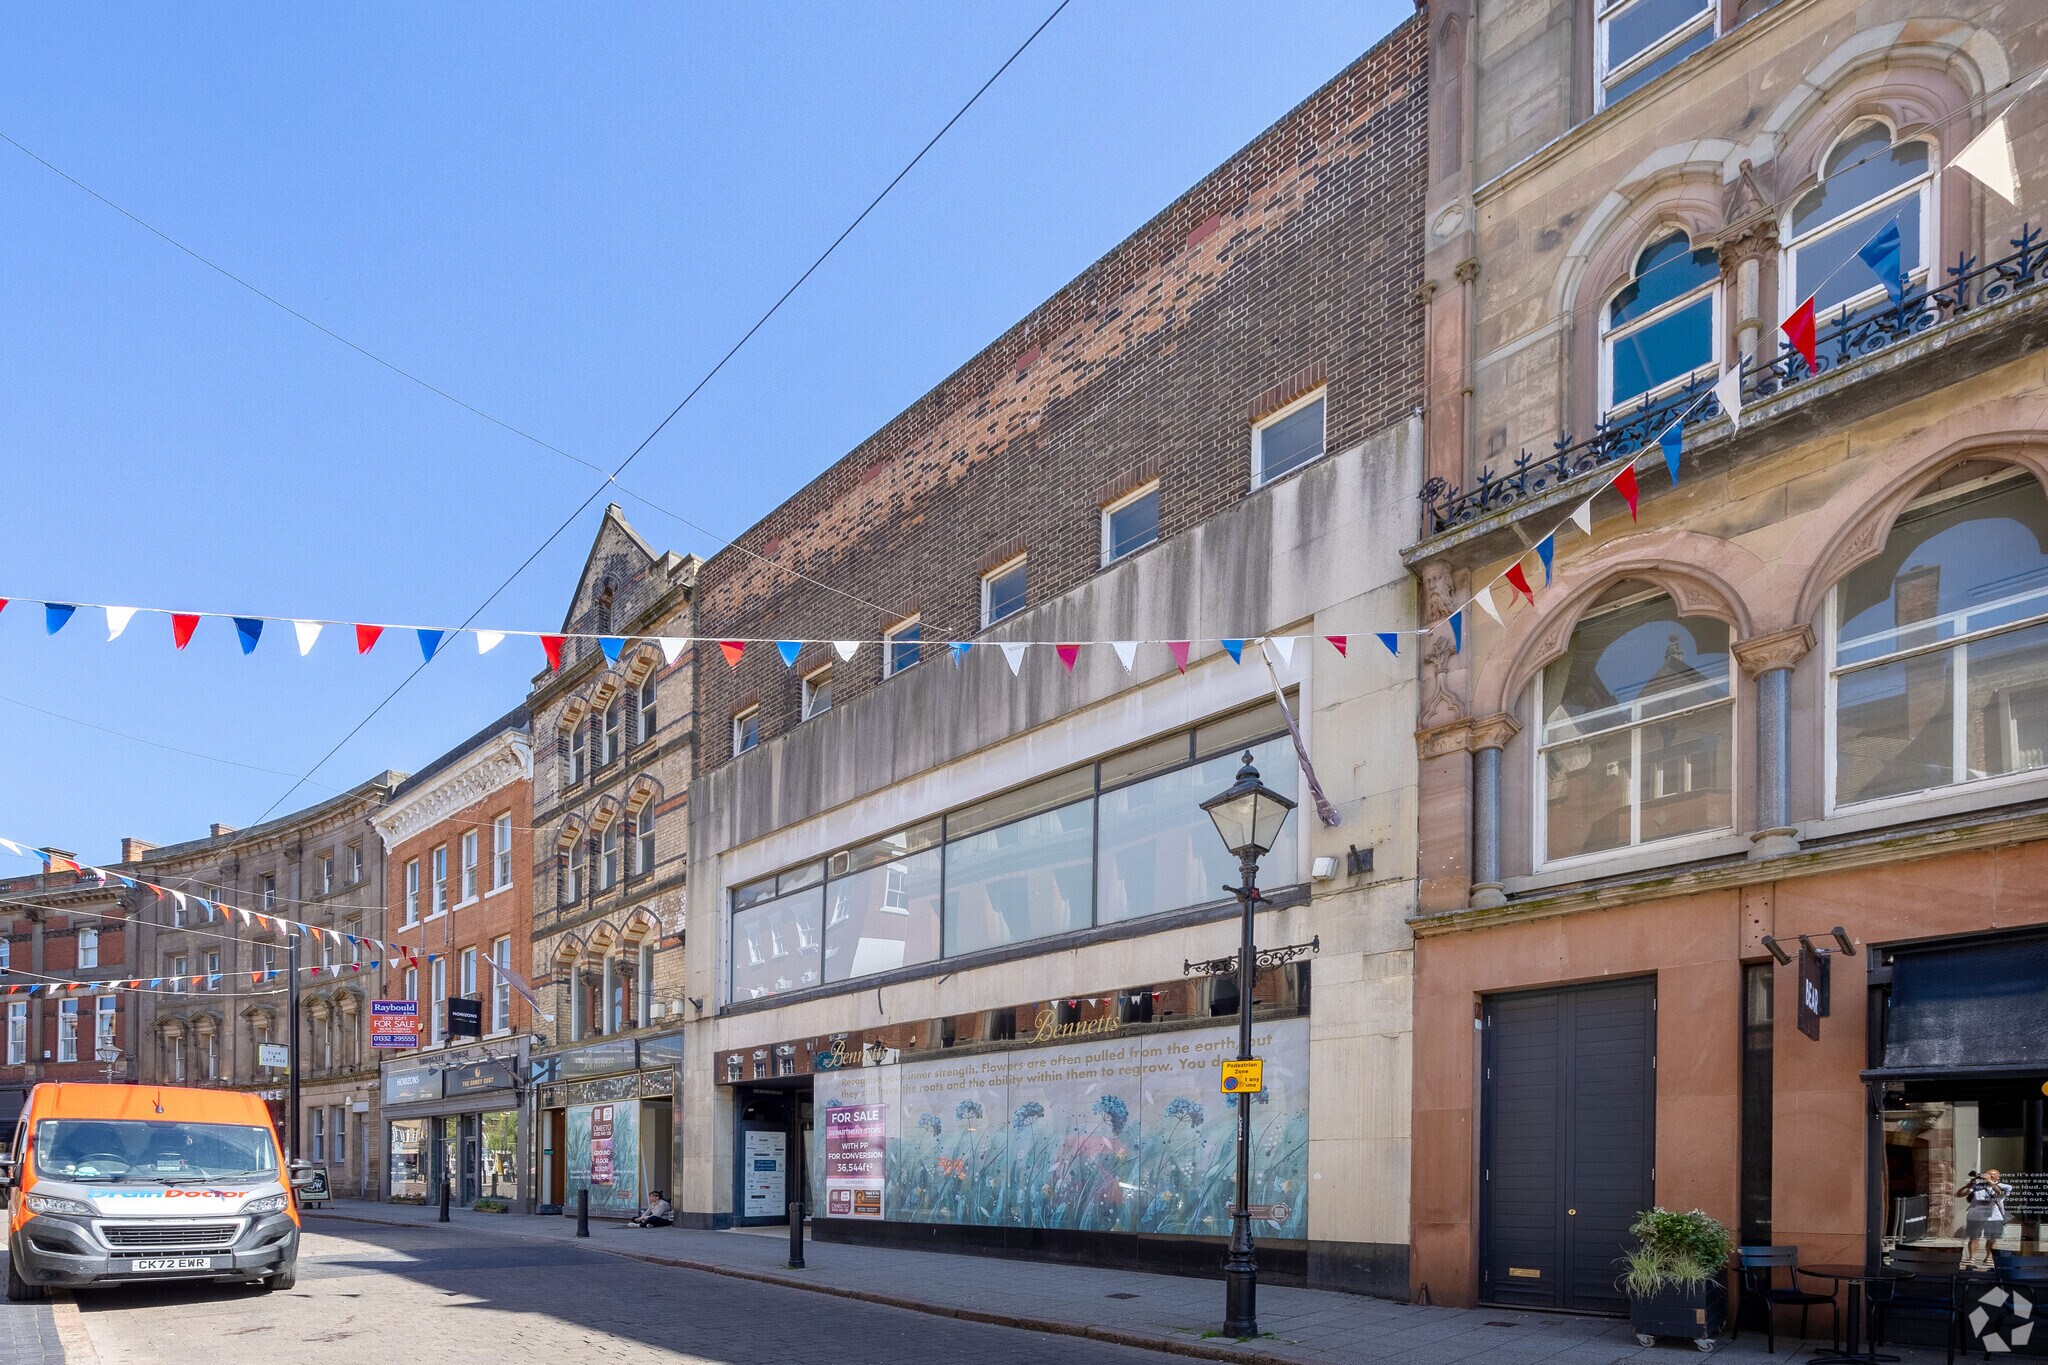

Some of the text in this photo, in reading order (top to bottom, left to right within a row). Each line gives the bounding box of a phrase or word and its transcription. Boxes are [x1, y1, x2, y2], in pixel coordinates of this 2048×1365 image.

[374, 1003, 416, 1012] Raybould
[374, 1020, 415, 1028] FOR SALE
[1026, 1008, 1120, 1044] Bennetts
[825, 1039, 888, 1068] Bennetts
[908, 1071, 931, 1080] inner
[935, 1064, 978, 1079] strength.
[981, 1062, 1024, 1073] Flowers
[1027, 1059, 1046, 1069] are
[1051, 1054, 1081, 1066] often
[1085, 1048, 1125, 1065] pulled
[1129, 1046, 1162, 1059] from
[1167, 1043, 1190, 1055] the
[1194, 1036, 1239, 1051] earth,
[396, 1076, 420, 1087] HORIZONS
[841, 1089, 859, 1100] they
[902, 1084, 917, 1094] the
[919, 1082, 944, 1093] roots
[947, 1079, 966, 1090] and
[969, 1078, 985, 1088] the
[988, 1074, 1023, 1087] ability
[1027, 1071, 1063, 1083] within
[1066, 1068, 1097, 1080] them
[1101, 1065, 1115, 1077] to
[1119, 1063, 1173, 1078] regrow.
[1178, 1058, 1206, 1070] You
[831, 1110, 879, 1123] FOR SALE
[859, 1141, 869, 1149] PP
[828, 1151, 883, 1160] FOR CONVERSION
[138, 1259, 204, 1269] CK72 EWR
